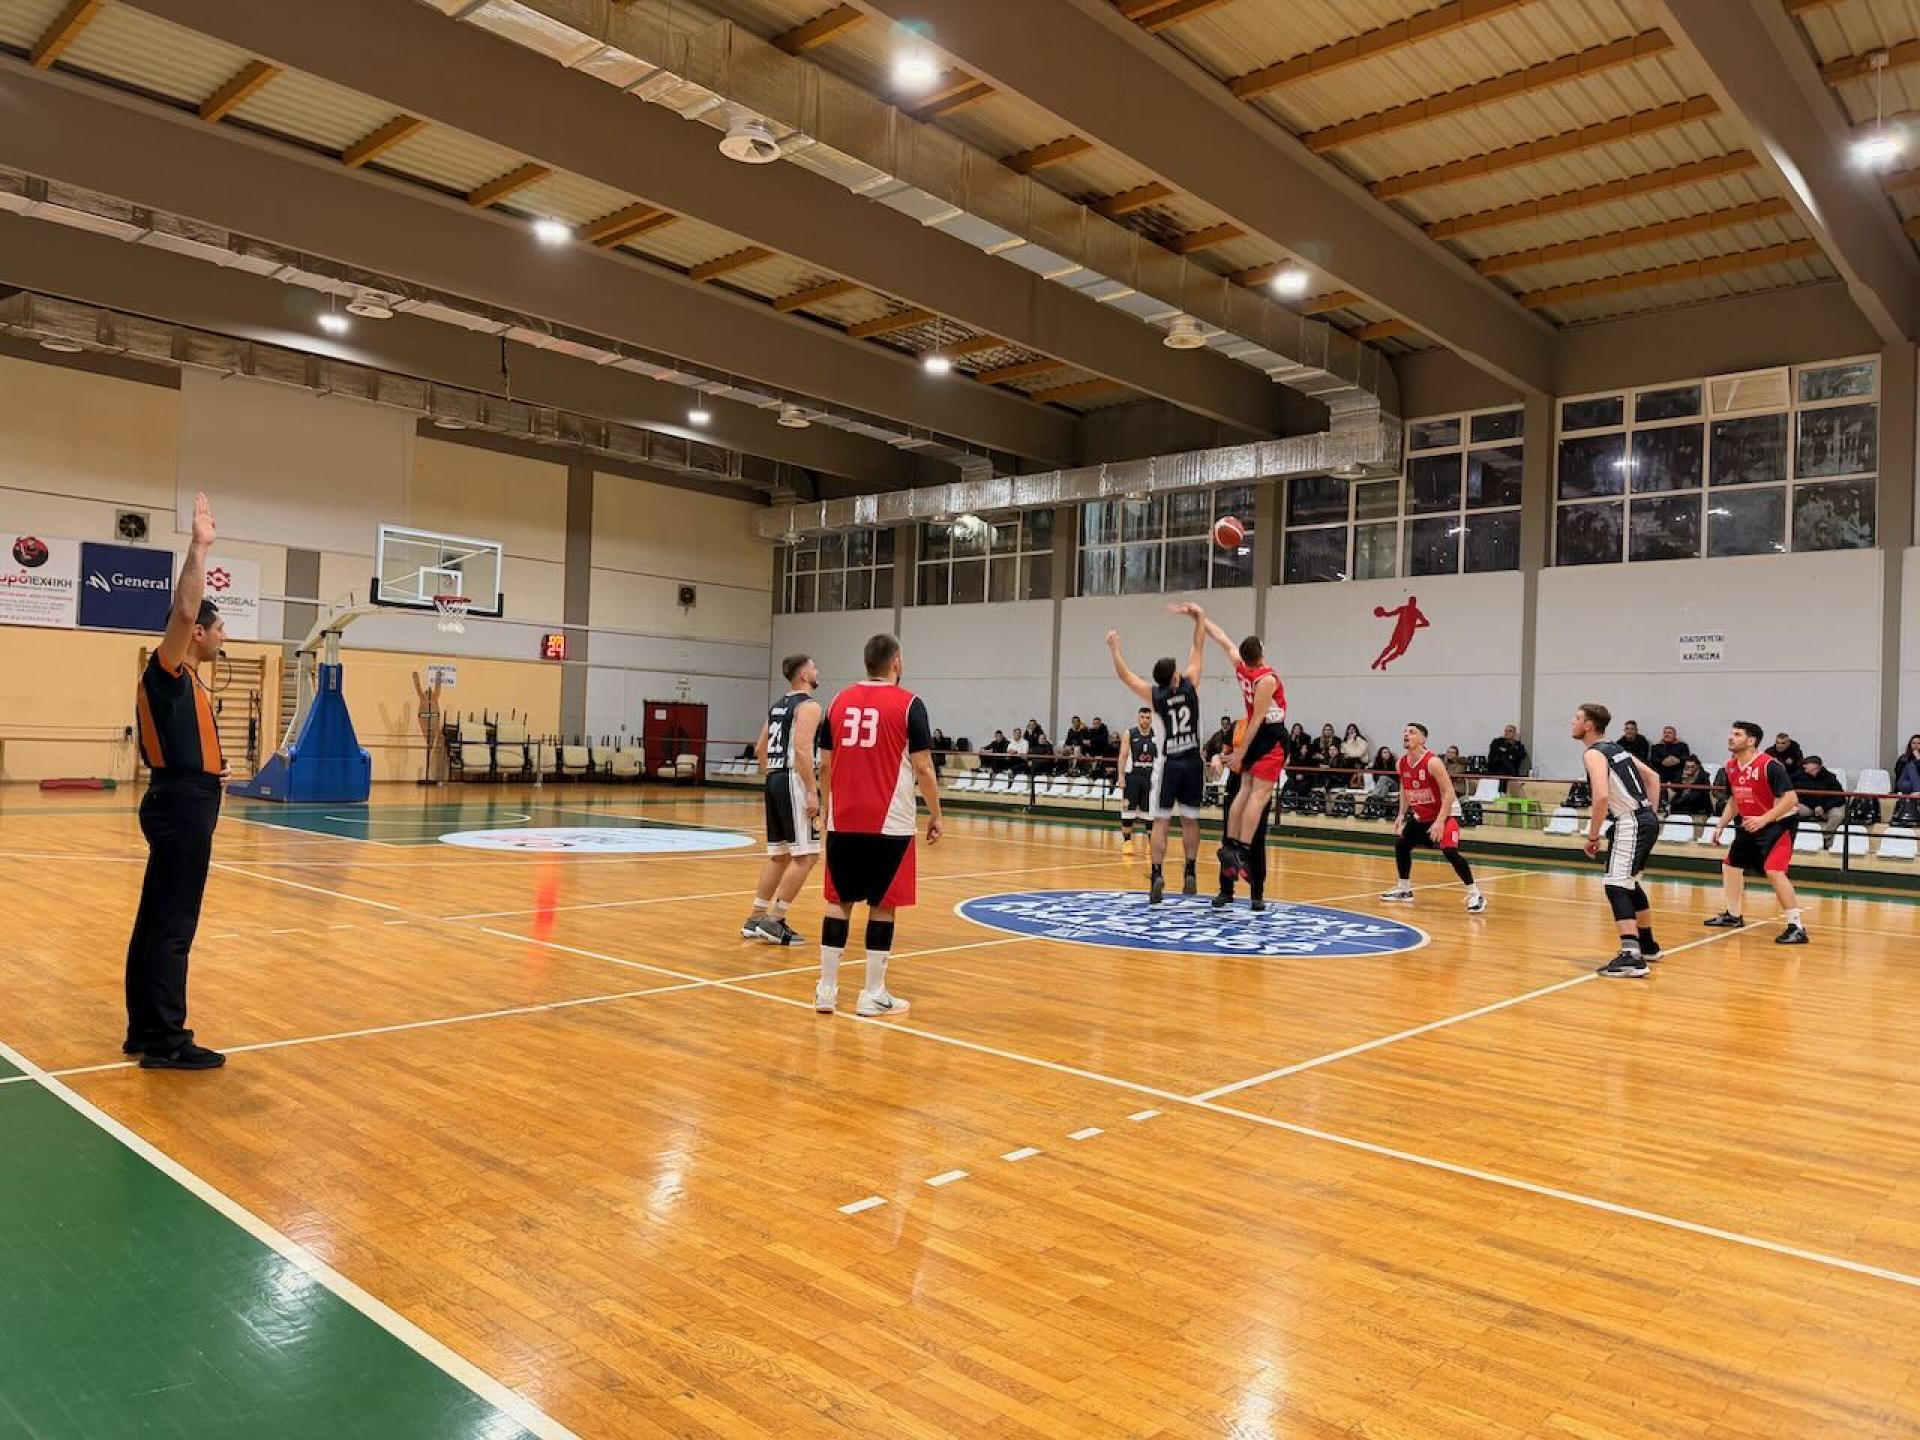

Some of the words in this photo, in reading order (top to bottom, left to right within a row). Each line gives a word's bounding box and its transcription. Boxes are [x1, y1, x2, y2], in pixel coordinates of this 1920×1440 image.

[111, 573, 169, 590] General
[207, 595, 257, 607] NOSEAL
[841, 706, 879, 748] 33
[1168, 706, 1191, 736] 12
